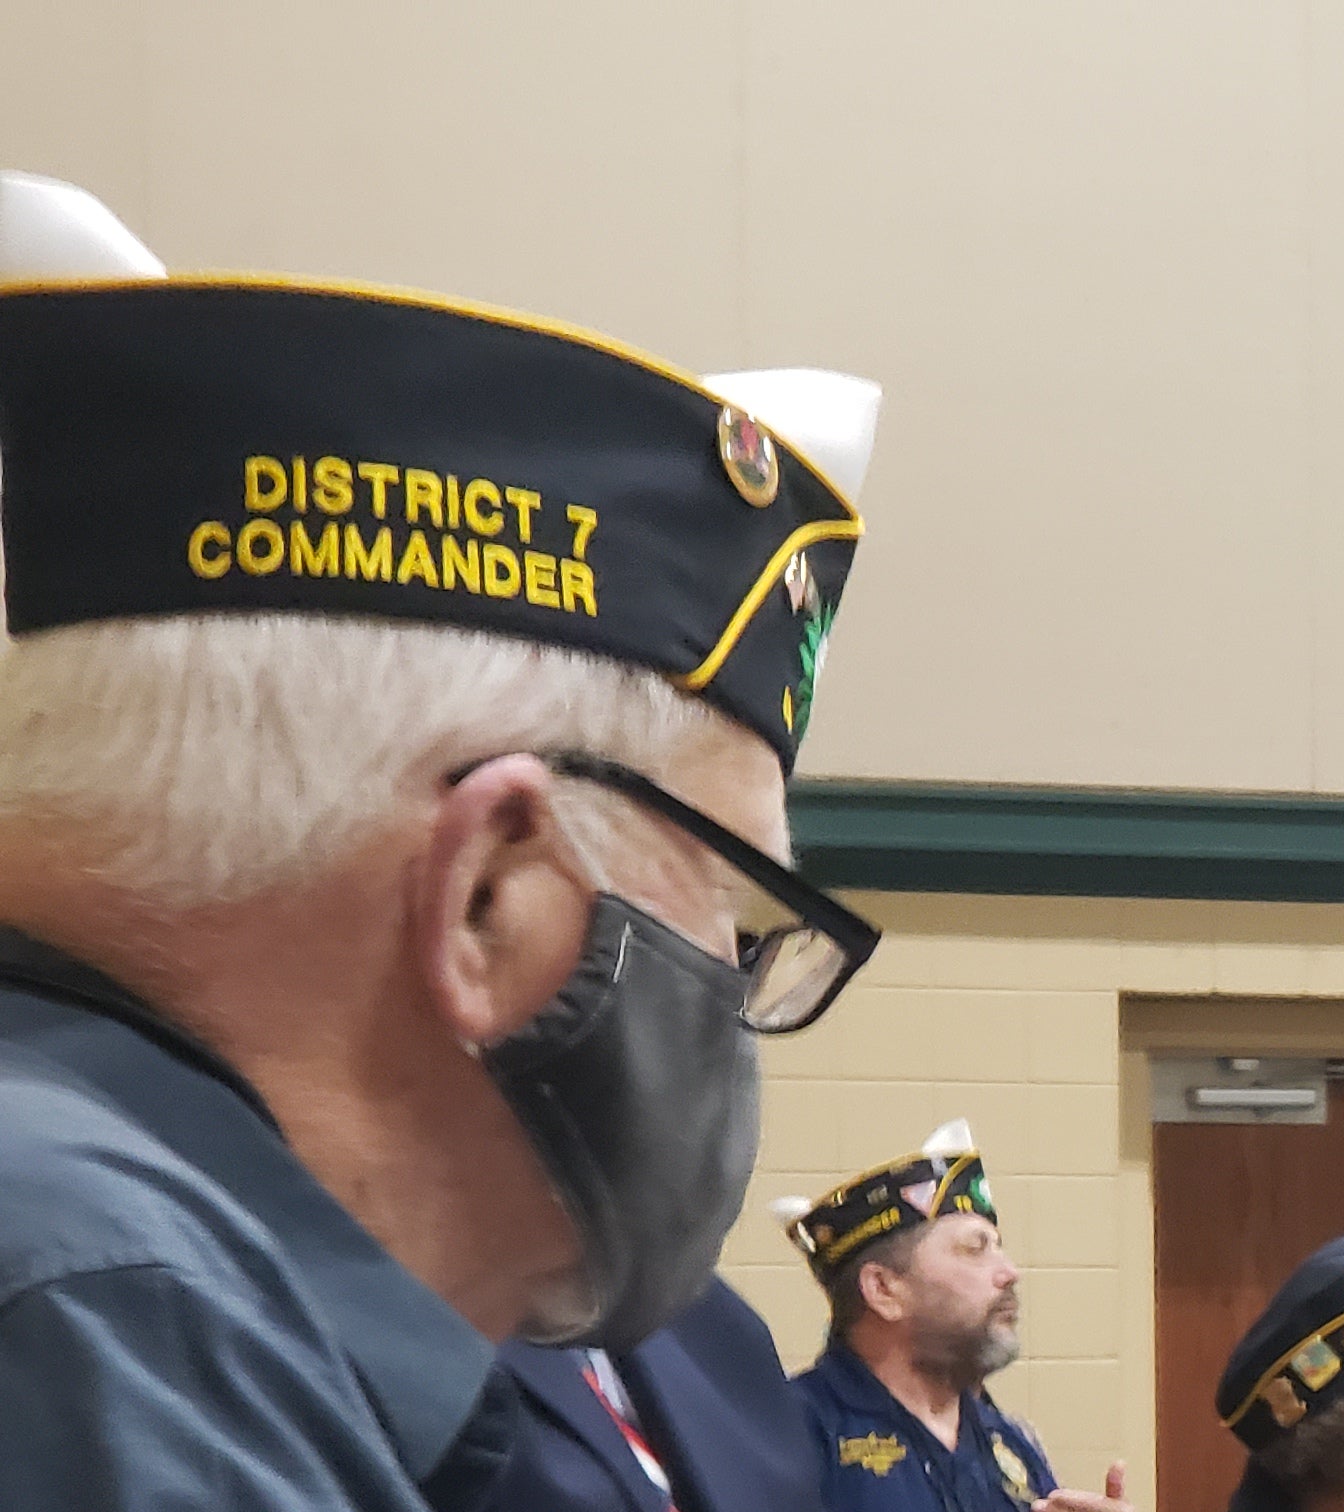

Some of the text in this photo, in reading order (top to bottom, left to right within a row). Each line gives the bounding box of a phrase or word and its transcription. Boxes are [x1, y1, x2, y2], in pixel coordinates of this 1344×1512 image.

[245, 455, 598, 560] DISTRICT 7
[187, 518, 598, 617] COMMANDER
